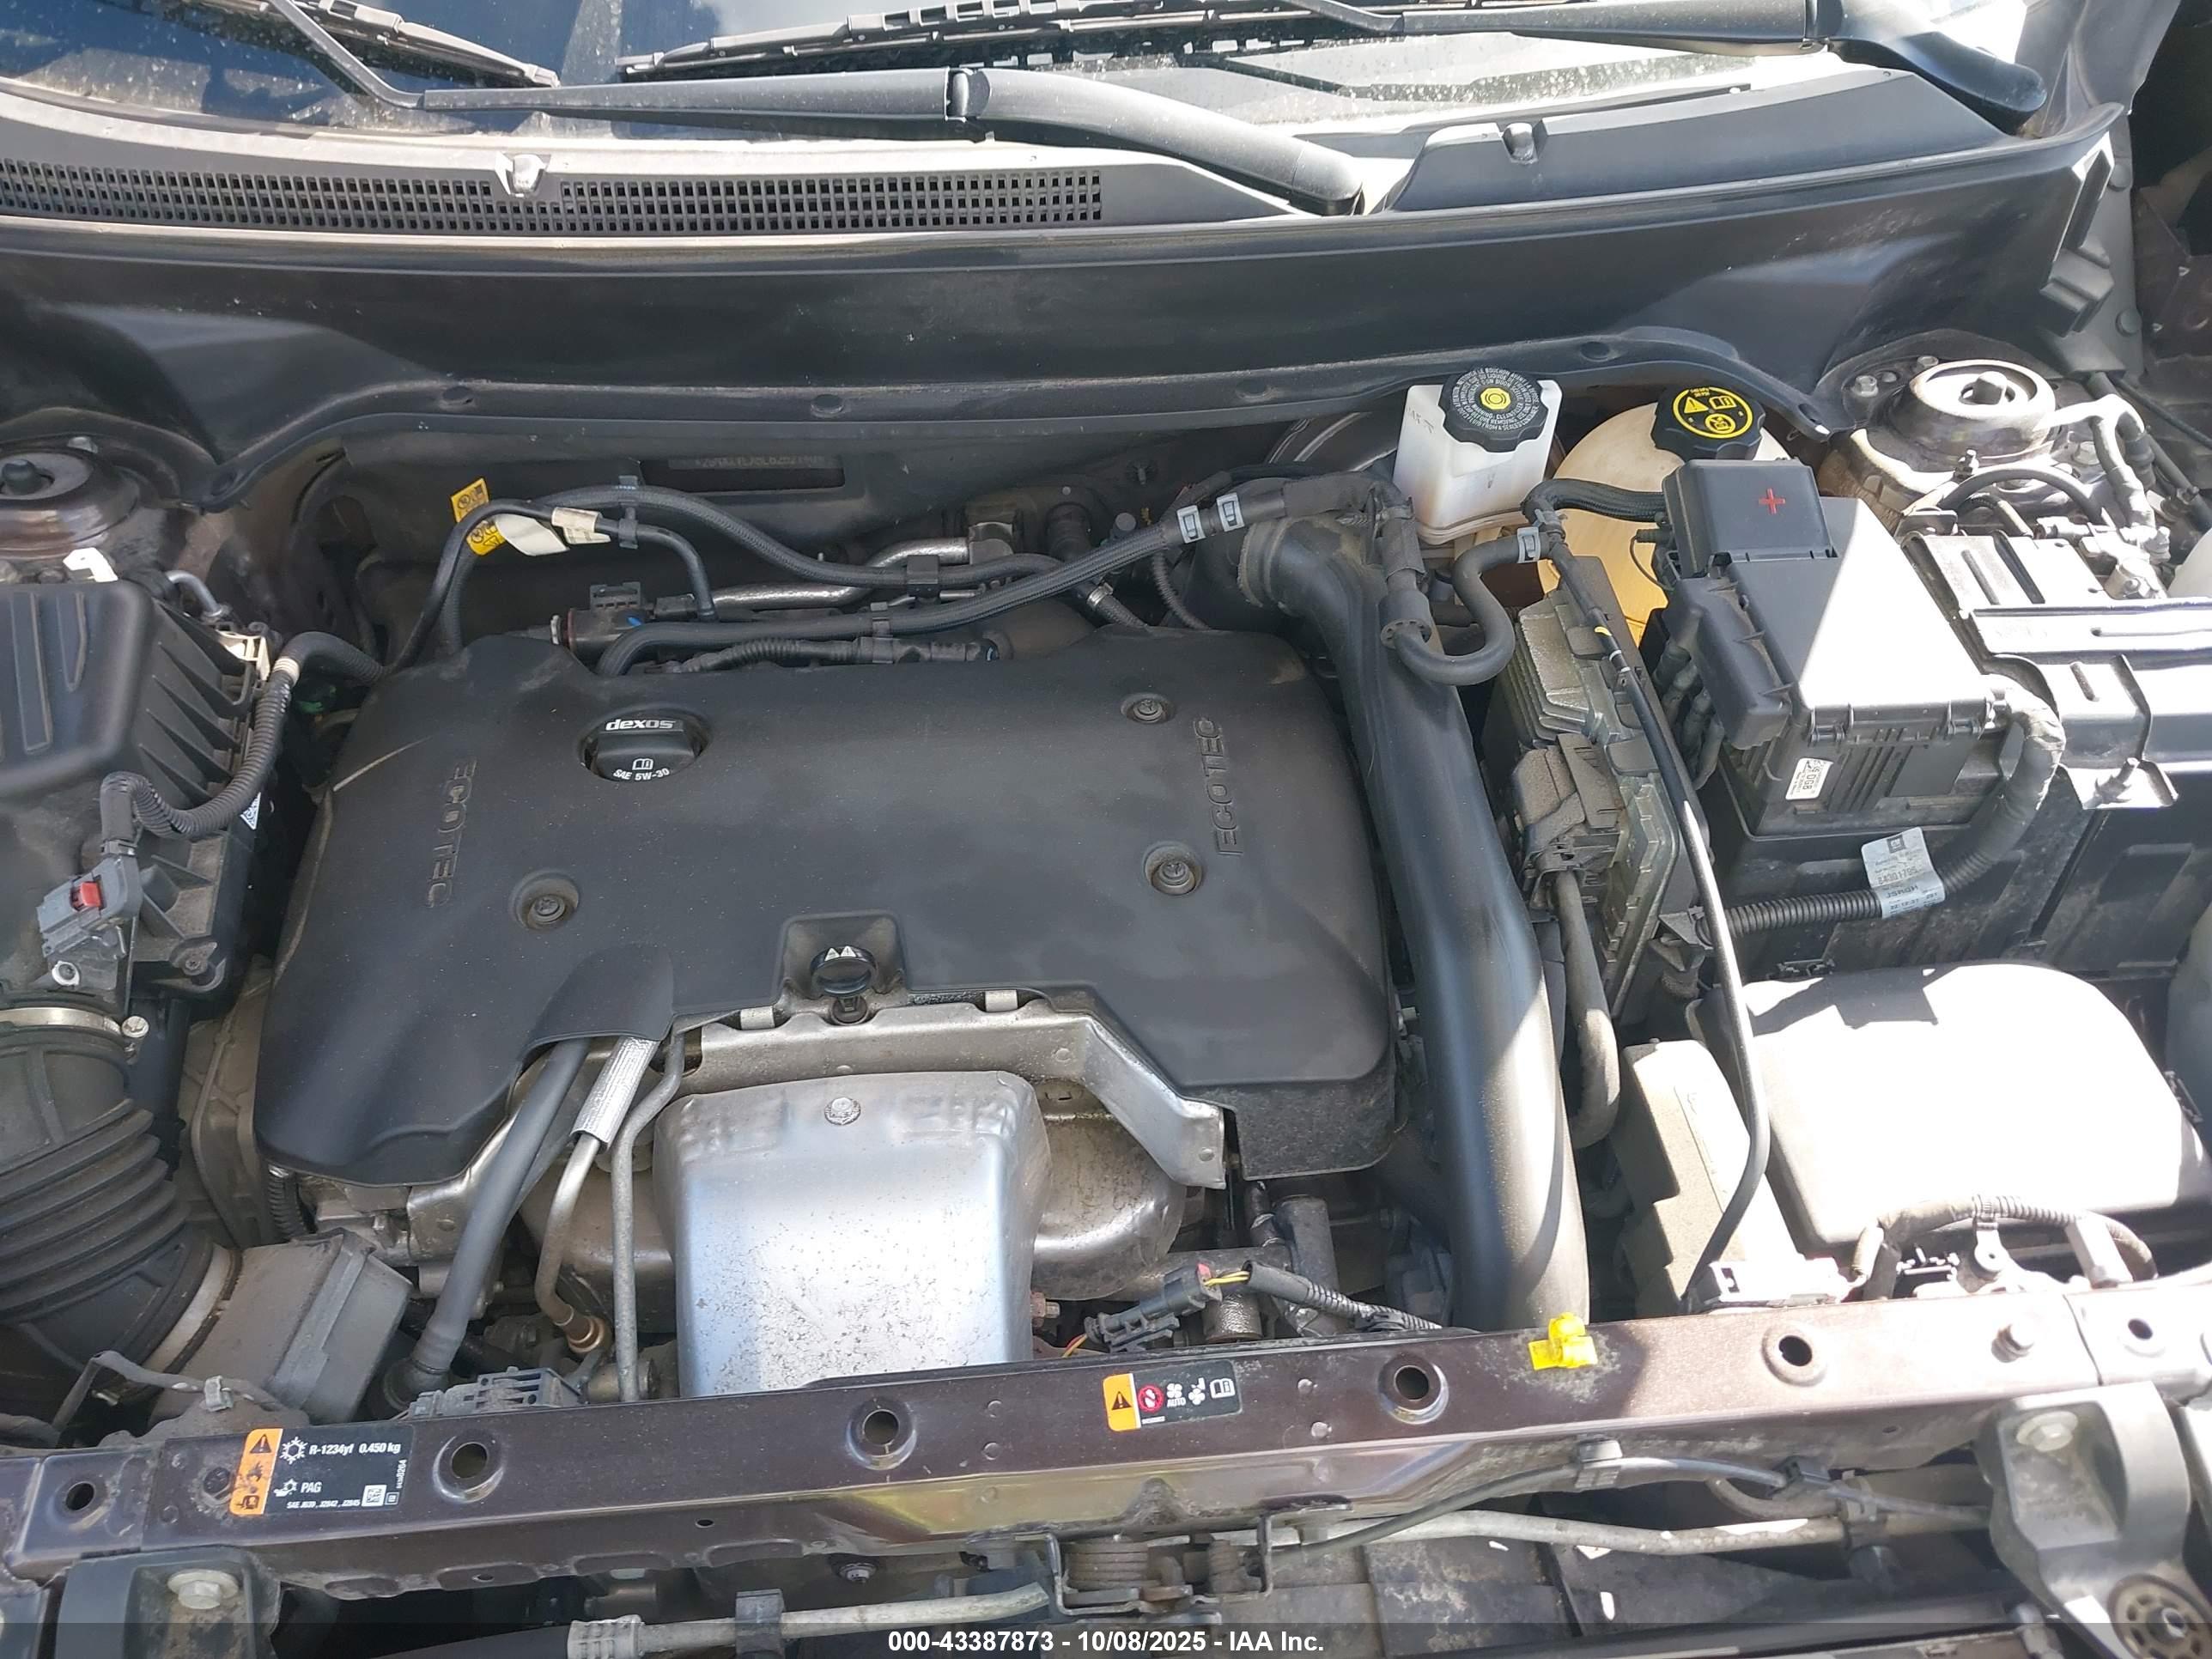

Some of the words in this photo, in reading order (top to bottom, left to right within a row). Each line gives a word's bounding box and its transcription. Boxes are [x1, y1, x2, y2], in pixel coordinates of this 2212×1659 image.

[605, 719, 676, 731] dexos
[613, 769, 632, 781] SAE
[635, 768, 671, 781] 5W-30
[1193, 717, 1244, 856] ECOTEC
[426, 757, 477, 908] ECOTEC
[1167, 1397, 1187, 1407] AUTO
[308, 1443, 355, 1456] R-1234yf
[359, 1443, 386, 1454] 0.450
[387, 1442, 401, 1455] kg
[301, 1481, 322, 1493] PAG
